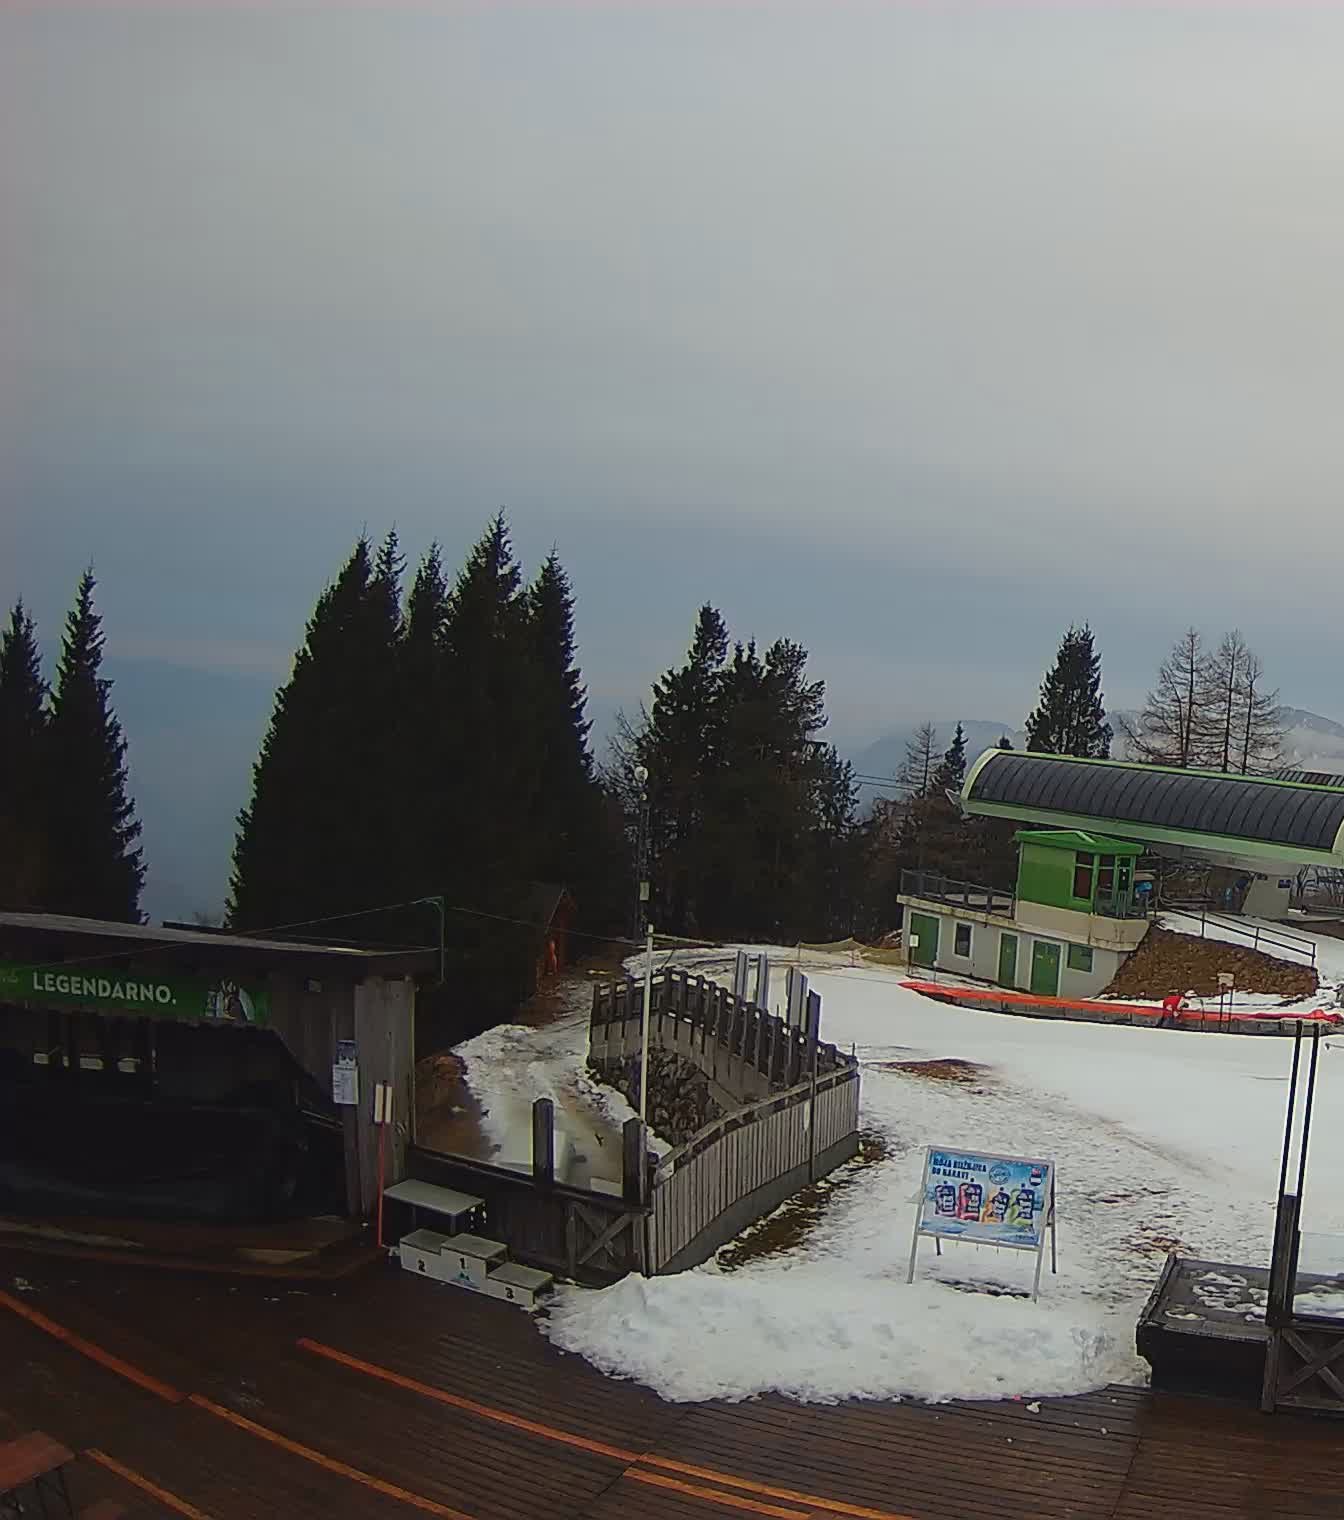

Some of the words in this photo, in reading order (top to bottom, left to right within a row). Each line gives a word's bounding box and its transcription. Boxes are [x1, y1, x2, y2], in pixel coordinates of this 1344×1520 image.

[32, 972, 177, 1005] LEGENDARNO.
[418, 1259, 425, 1272] 2
[459, 1257, 466, 1269] 1
[505, 1287, 514, 1299] 3
